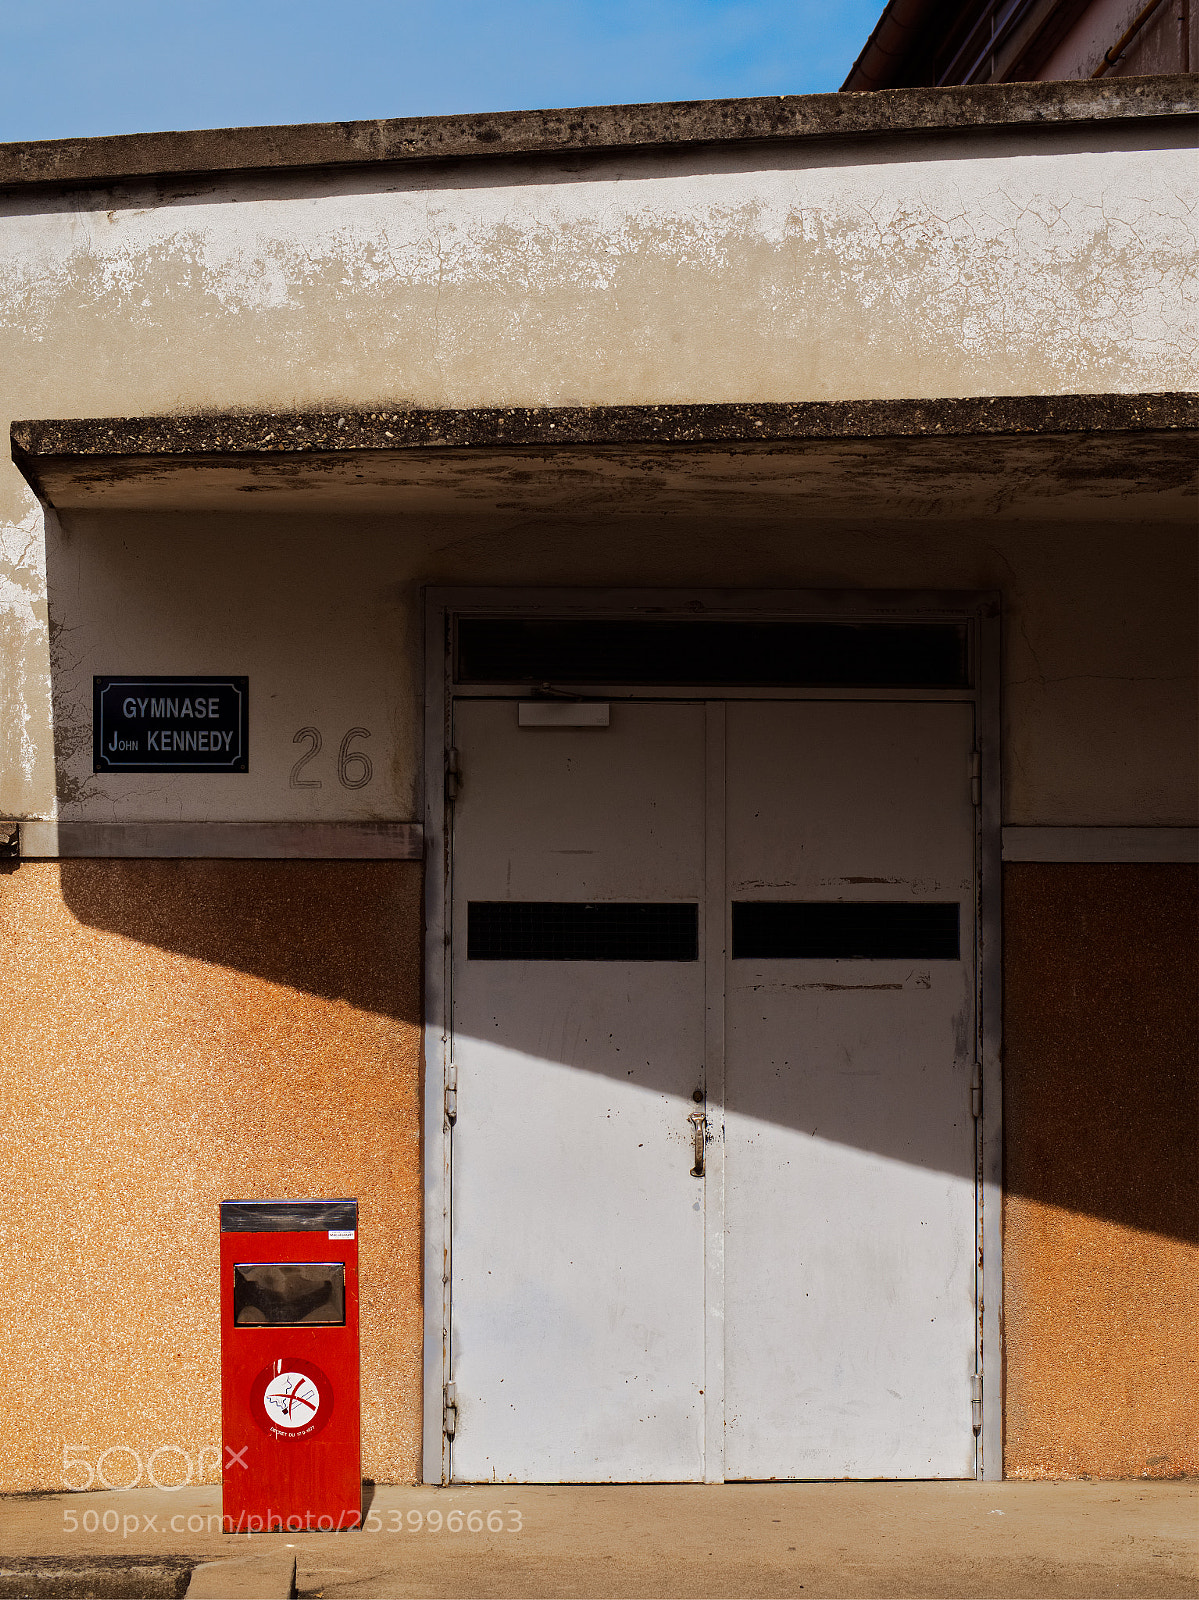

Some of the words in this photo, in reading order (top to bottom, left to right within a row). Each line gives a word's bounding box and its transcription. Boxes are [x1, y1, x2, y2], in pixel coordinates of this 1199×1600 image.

[122, 697, 220, 719] GYMNASE
[108, 730, 139, 752] JOHN
[147, 730, 234, 752] KENNEDY
[289, 726, 373, 790] 26
